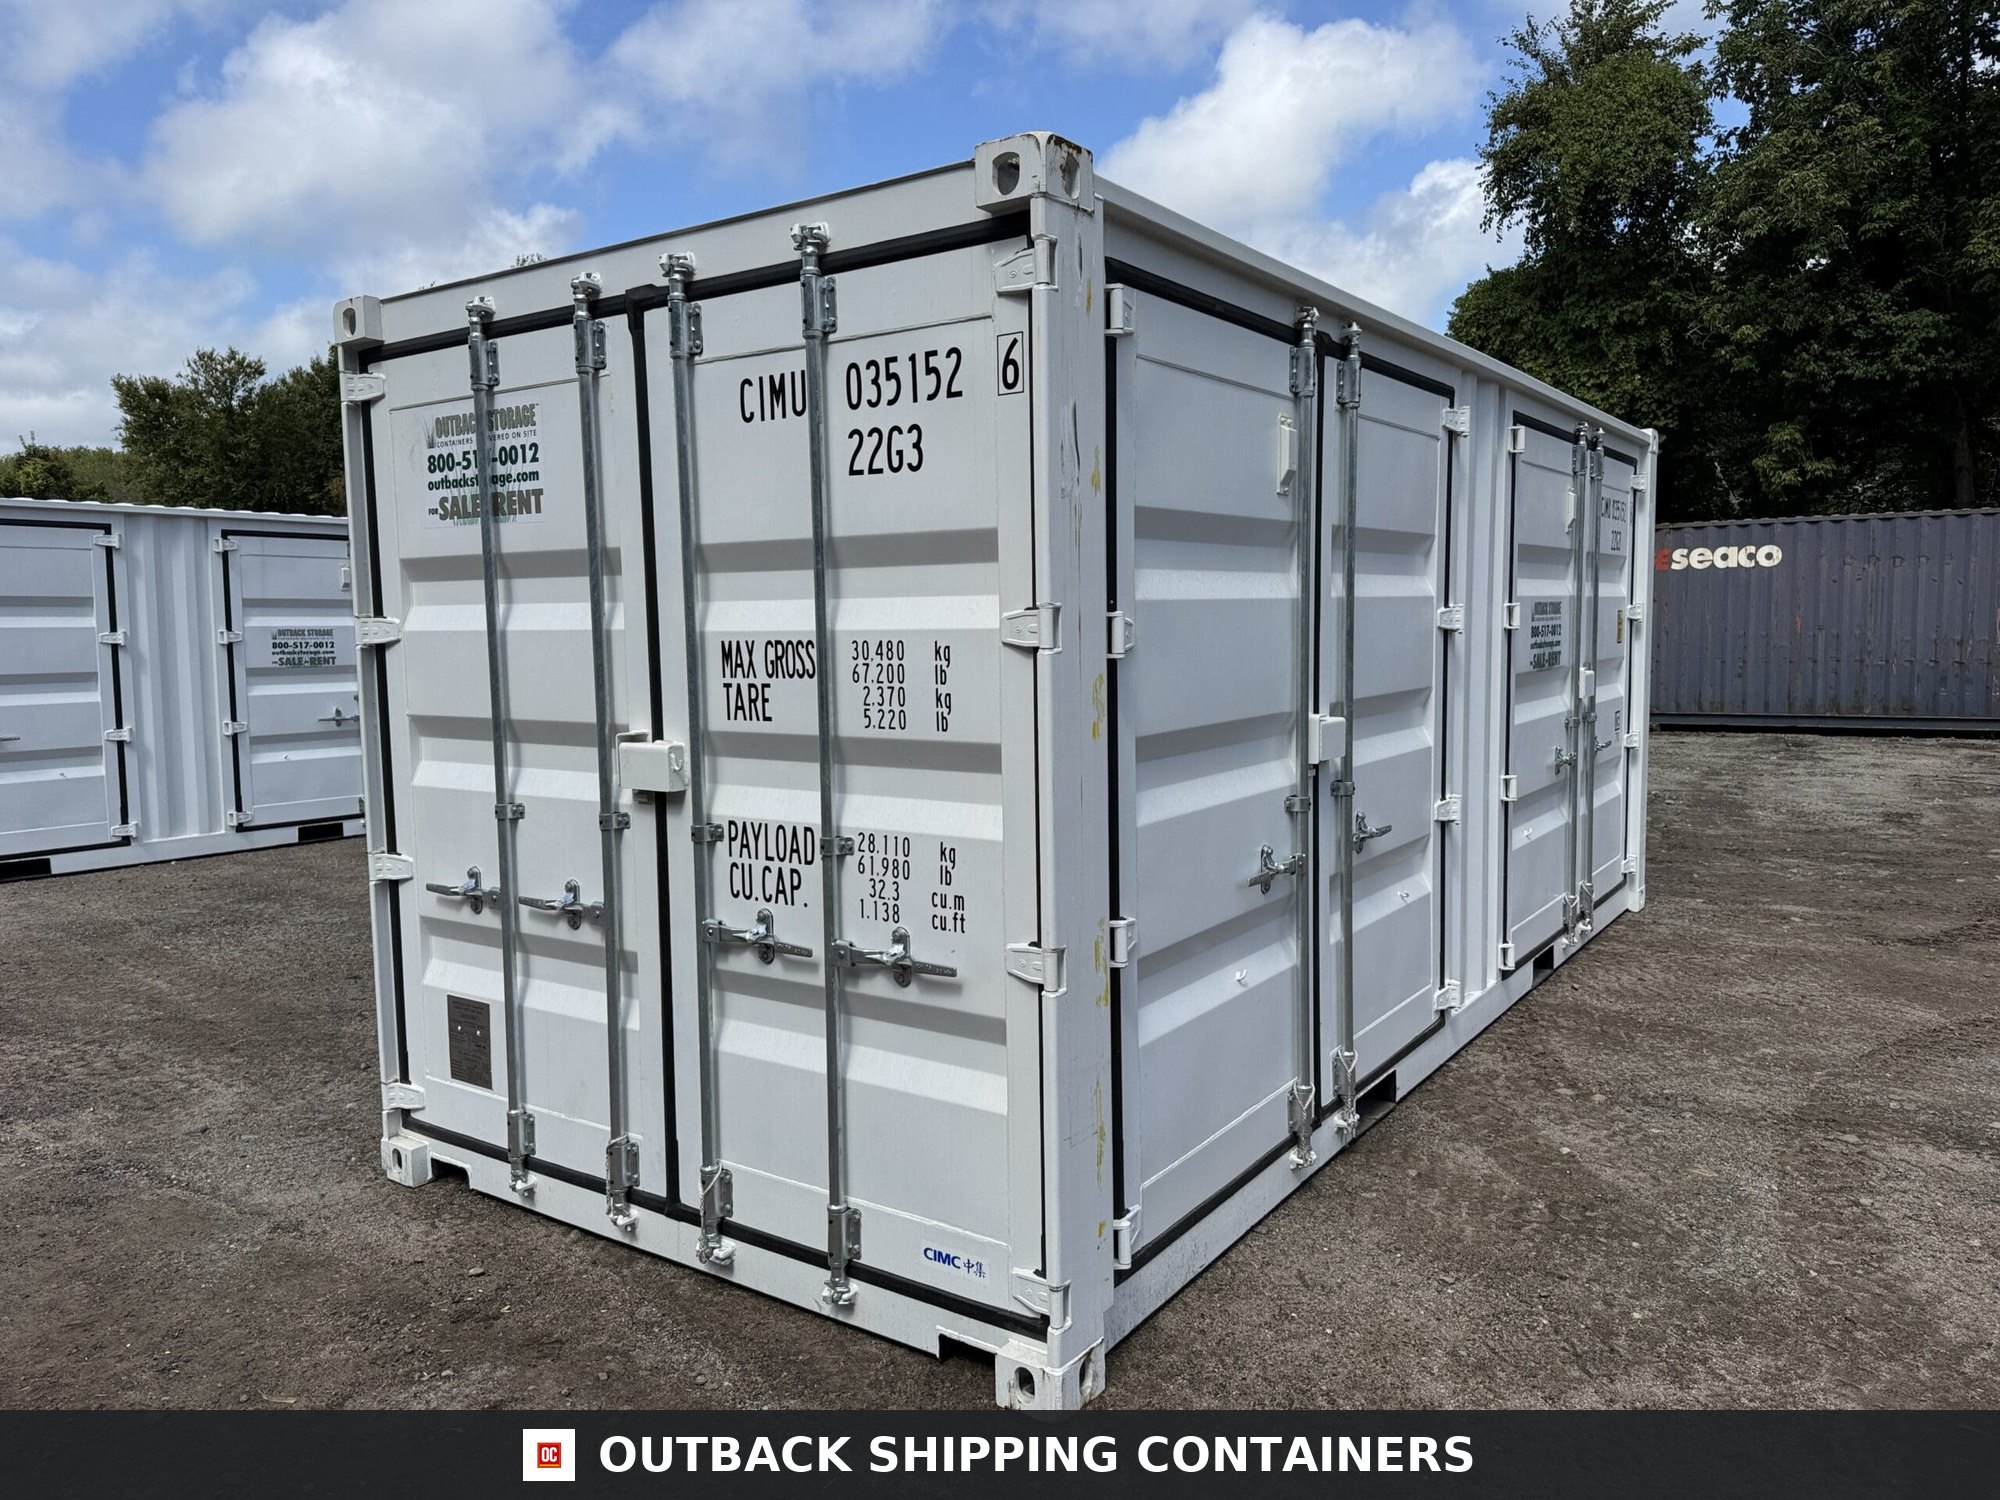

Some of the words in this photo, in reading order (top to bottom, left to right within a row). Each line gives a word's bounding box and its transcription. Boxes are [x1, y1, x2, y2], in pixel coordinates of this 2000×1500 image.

[740, 369, 807, 424] CIMU
[845, 346, 963, 411] 035152
[1001, 336, 1021, 391] 6
[435, 412, 477, 439] OUTBAC
[487, 403, 537, 432] STORAGE
[436, 437, 474, 449] CONTAINERS
[511, 430, 521, 439] ON
[523, 429, 538, 439] SITE
[848, 423, 924, 476] 22G3
[427, 442, 540, 474] 800-51-0012
[427, 470, 540, 491] outbackstage.com
[428, 508, 439, 516] FOR
[439, 493, 481, 521] SALE
[490, 488, 544, 517] RENT
[278, 628, 306, 637] OUTBACK
[272, 641, 335, 649] 800-517-0012
[278, 657, 304, 666] SALE
[310, 656, 336, 666] RENT
[721, 639, 757, 679] MAX
[764, 639, 817, 679] GROSS
[934, 640, 951, 668] kg
[935, 663, 947, 685] lb
[722, 682, 773, 722] TARE
[936, 688, 952, 715] kg
[936, 711, 949, 732] lb
[728, 820, 815, 866] PAYLOAD
[940, 841, 956, 869] kg
[729, 861, 809, 908] CU.CAP.
[869, 877, 900, 901] 32.3
[931, 891, 965, 912] cu.m
[940, 864, 952, 886] lb
[931, 911, 966, 934] cu.ft
[923, 1247, 961, 1270] CIMC
[963, 1258, 986, 1279] 中集
